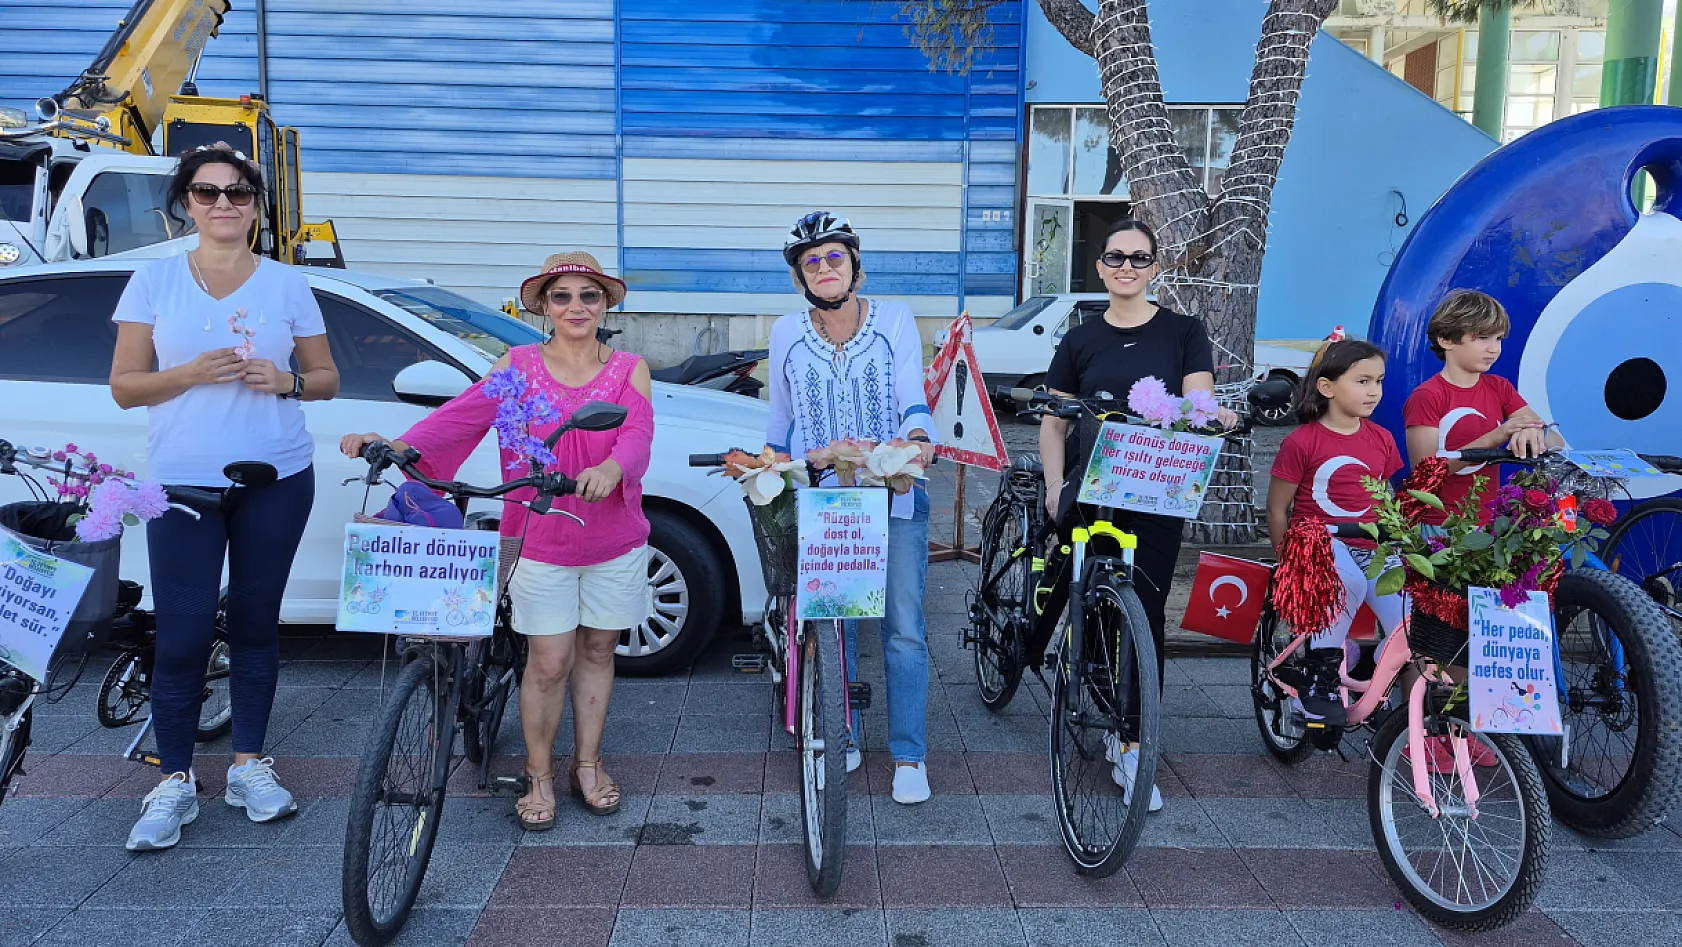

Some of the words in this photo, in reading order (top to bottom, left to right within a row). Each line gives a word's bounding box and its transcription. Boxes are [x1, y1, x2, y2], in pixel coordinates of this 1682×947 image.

[1104, 428, 1125, 441] Her
[1128, 431, 1166, 452] dönüş
[1167, 440, 1212, 456] doğaya,
[1101, 444, 1122, 458] her
[1154, 455, 1207, 473] geleceğe
[1111, 463, 1146, 480] miras
[1149, 470, 1187, 484] olsun!
[824, 527, 849, 540] dost
[851, 527, 864, 541] ol,
[348, 533, 421, 555] Pedallar
[426, 538, 496, 562] dönüyor
[807, 543, 850, 559] doğayla
[853, 543, 881, 559] barış
[354, 559, 413, 578] karbon
[419, 562, 488, 585] azalıyor
[800, 558, 834, 574] içinde
[1482, 640, 1541, 663] dünyaya
[1474, 660, 1513, 679] nefes
[1517, 663, 1549, 681] olur.
